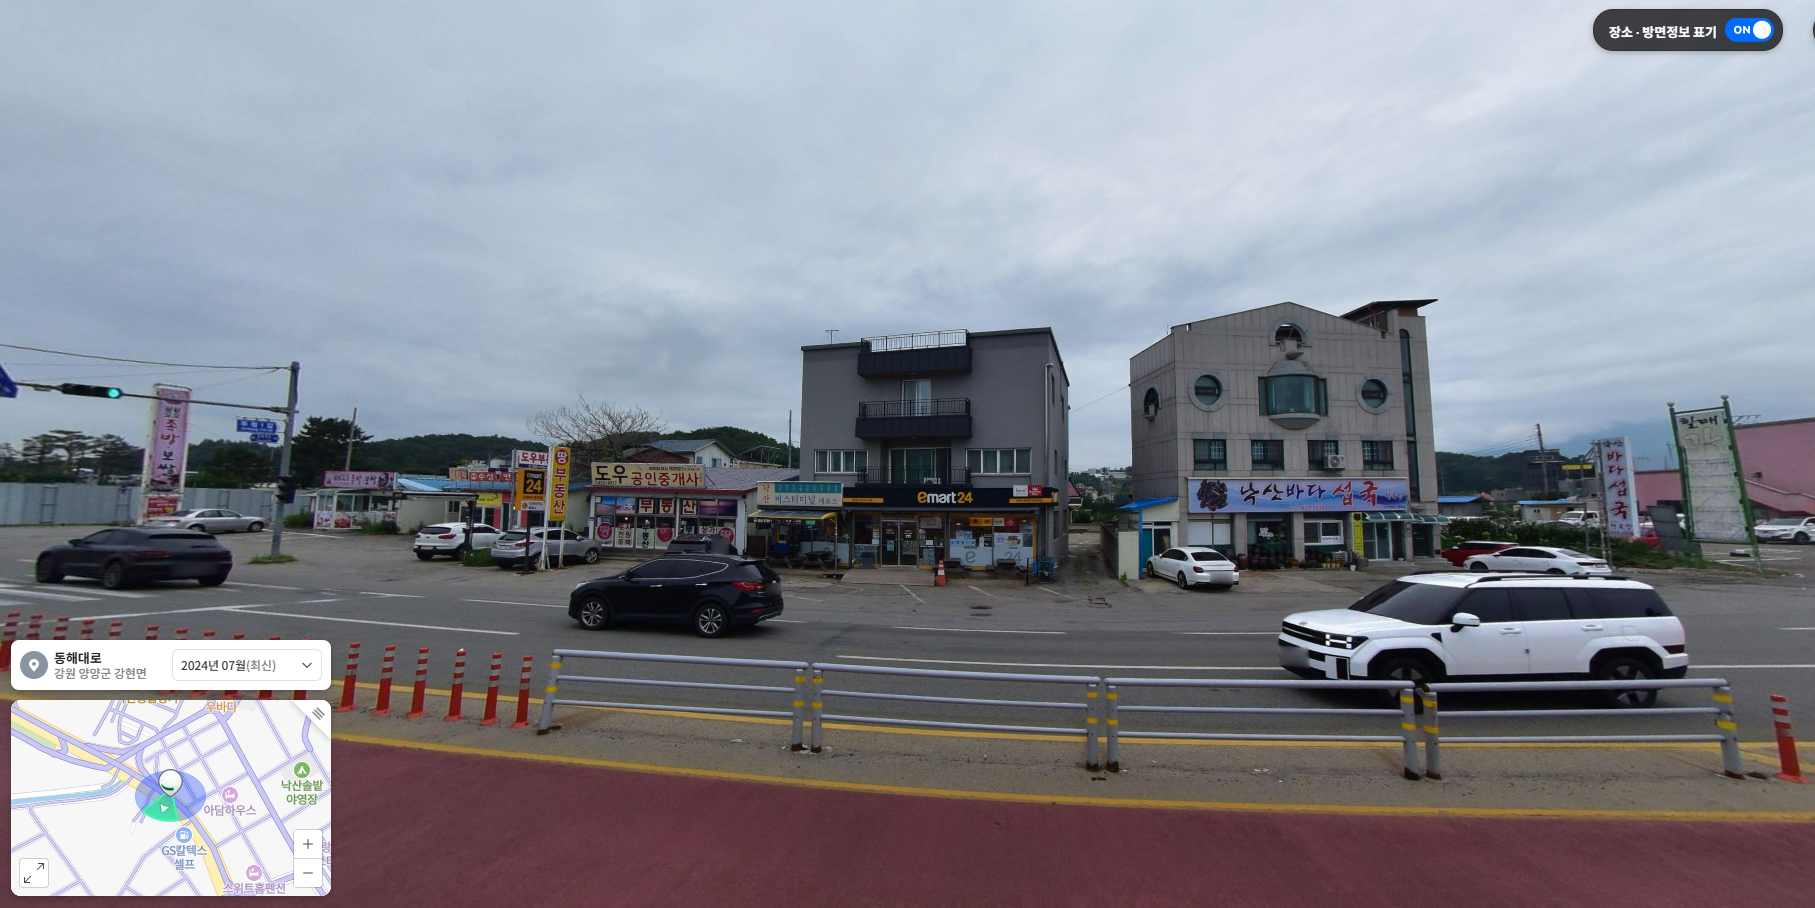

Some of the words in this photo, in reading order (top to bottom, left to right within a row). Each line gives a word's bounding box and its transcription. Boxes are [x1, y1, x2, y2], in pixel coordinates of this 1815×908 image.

[521, 451, 549, 464] 도우부
[556, 451, 568, 464] 땅
[595, 465, 628, 484] 도우
[631, 471, 699, 487] 공인중개사
[526, 480, 542, 493] 24
[553, 467, 567, 514] 부동산
[1332, 480, 1379, 507] 섭국
[917, 491, 974, 504] emart24
[641, 499, 696, 514] 부동산
